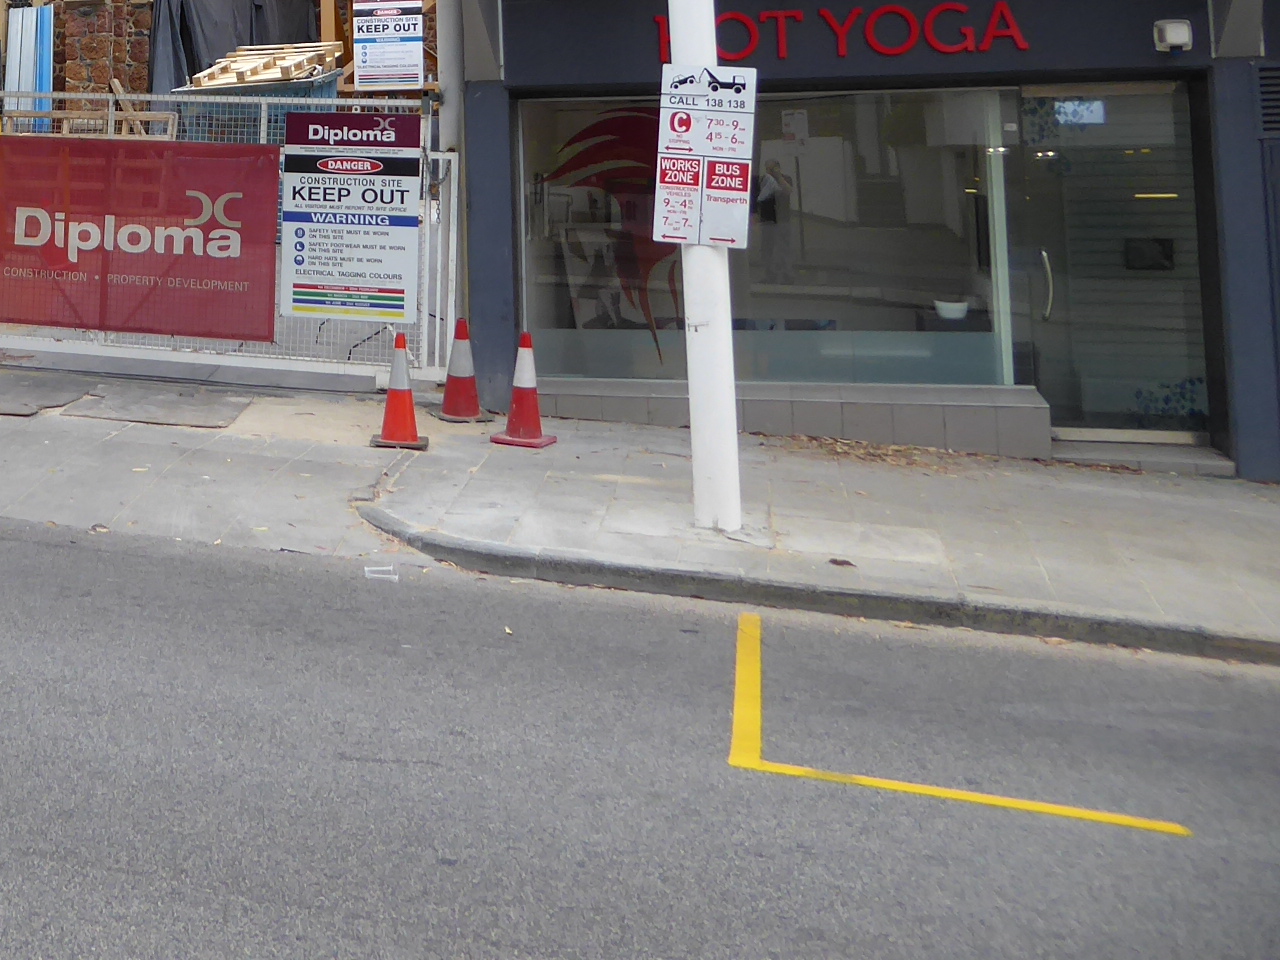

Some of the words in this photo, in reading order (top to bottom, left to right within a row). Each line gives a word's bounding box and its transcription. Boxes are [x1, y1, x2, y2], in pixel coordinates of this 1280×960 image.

[357, 24, 390, 34] KEEP
[393, 23, 419, 33] OUT
[819, 0, 1030, 57] YOGA
[669, 95, 699, 106] CALL
[705, 98, 723, 108] 138
[727, 99, 746, 109] 138
[673, 112, 687, 132] C
[308, 124, 396, 145] Diploma
[327, 160, 372, 171] DANGER
[661, 158, 699, 172] WORKS
[715, 163, 740, 176] BUS
[299, 176, 376, 187] CONSTRUCTION
[380, 178, 403, 188] SITE
[664, 170, 695, 184] ZONE
[710, 175, 744, 189] ZONE
[291, 186, 351, 202] KEEP
[361, 188, 410, 205] OUT
[705, 194, 748, 205] Transperth
[311, 213, 390, 225] WARNING
[14, 206, 242, 263] Diploma
[3, 266, 88, 282] CONSTRUCTION
[107, 273, 163, 287] PROPERTY
[167, 277, 250, 292] DEVELOPMENT
[295, 268, 335, 277] ELECTRICAL
[337, 270, 367, 279] TAGGING
[368, 272, 403, 280] COLOURS
